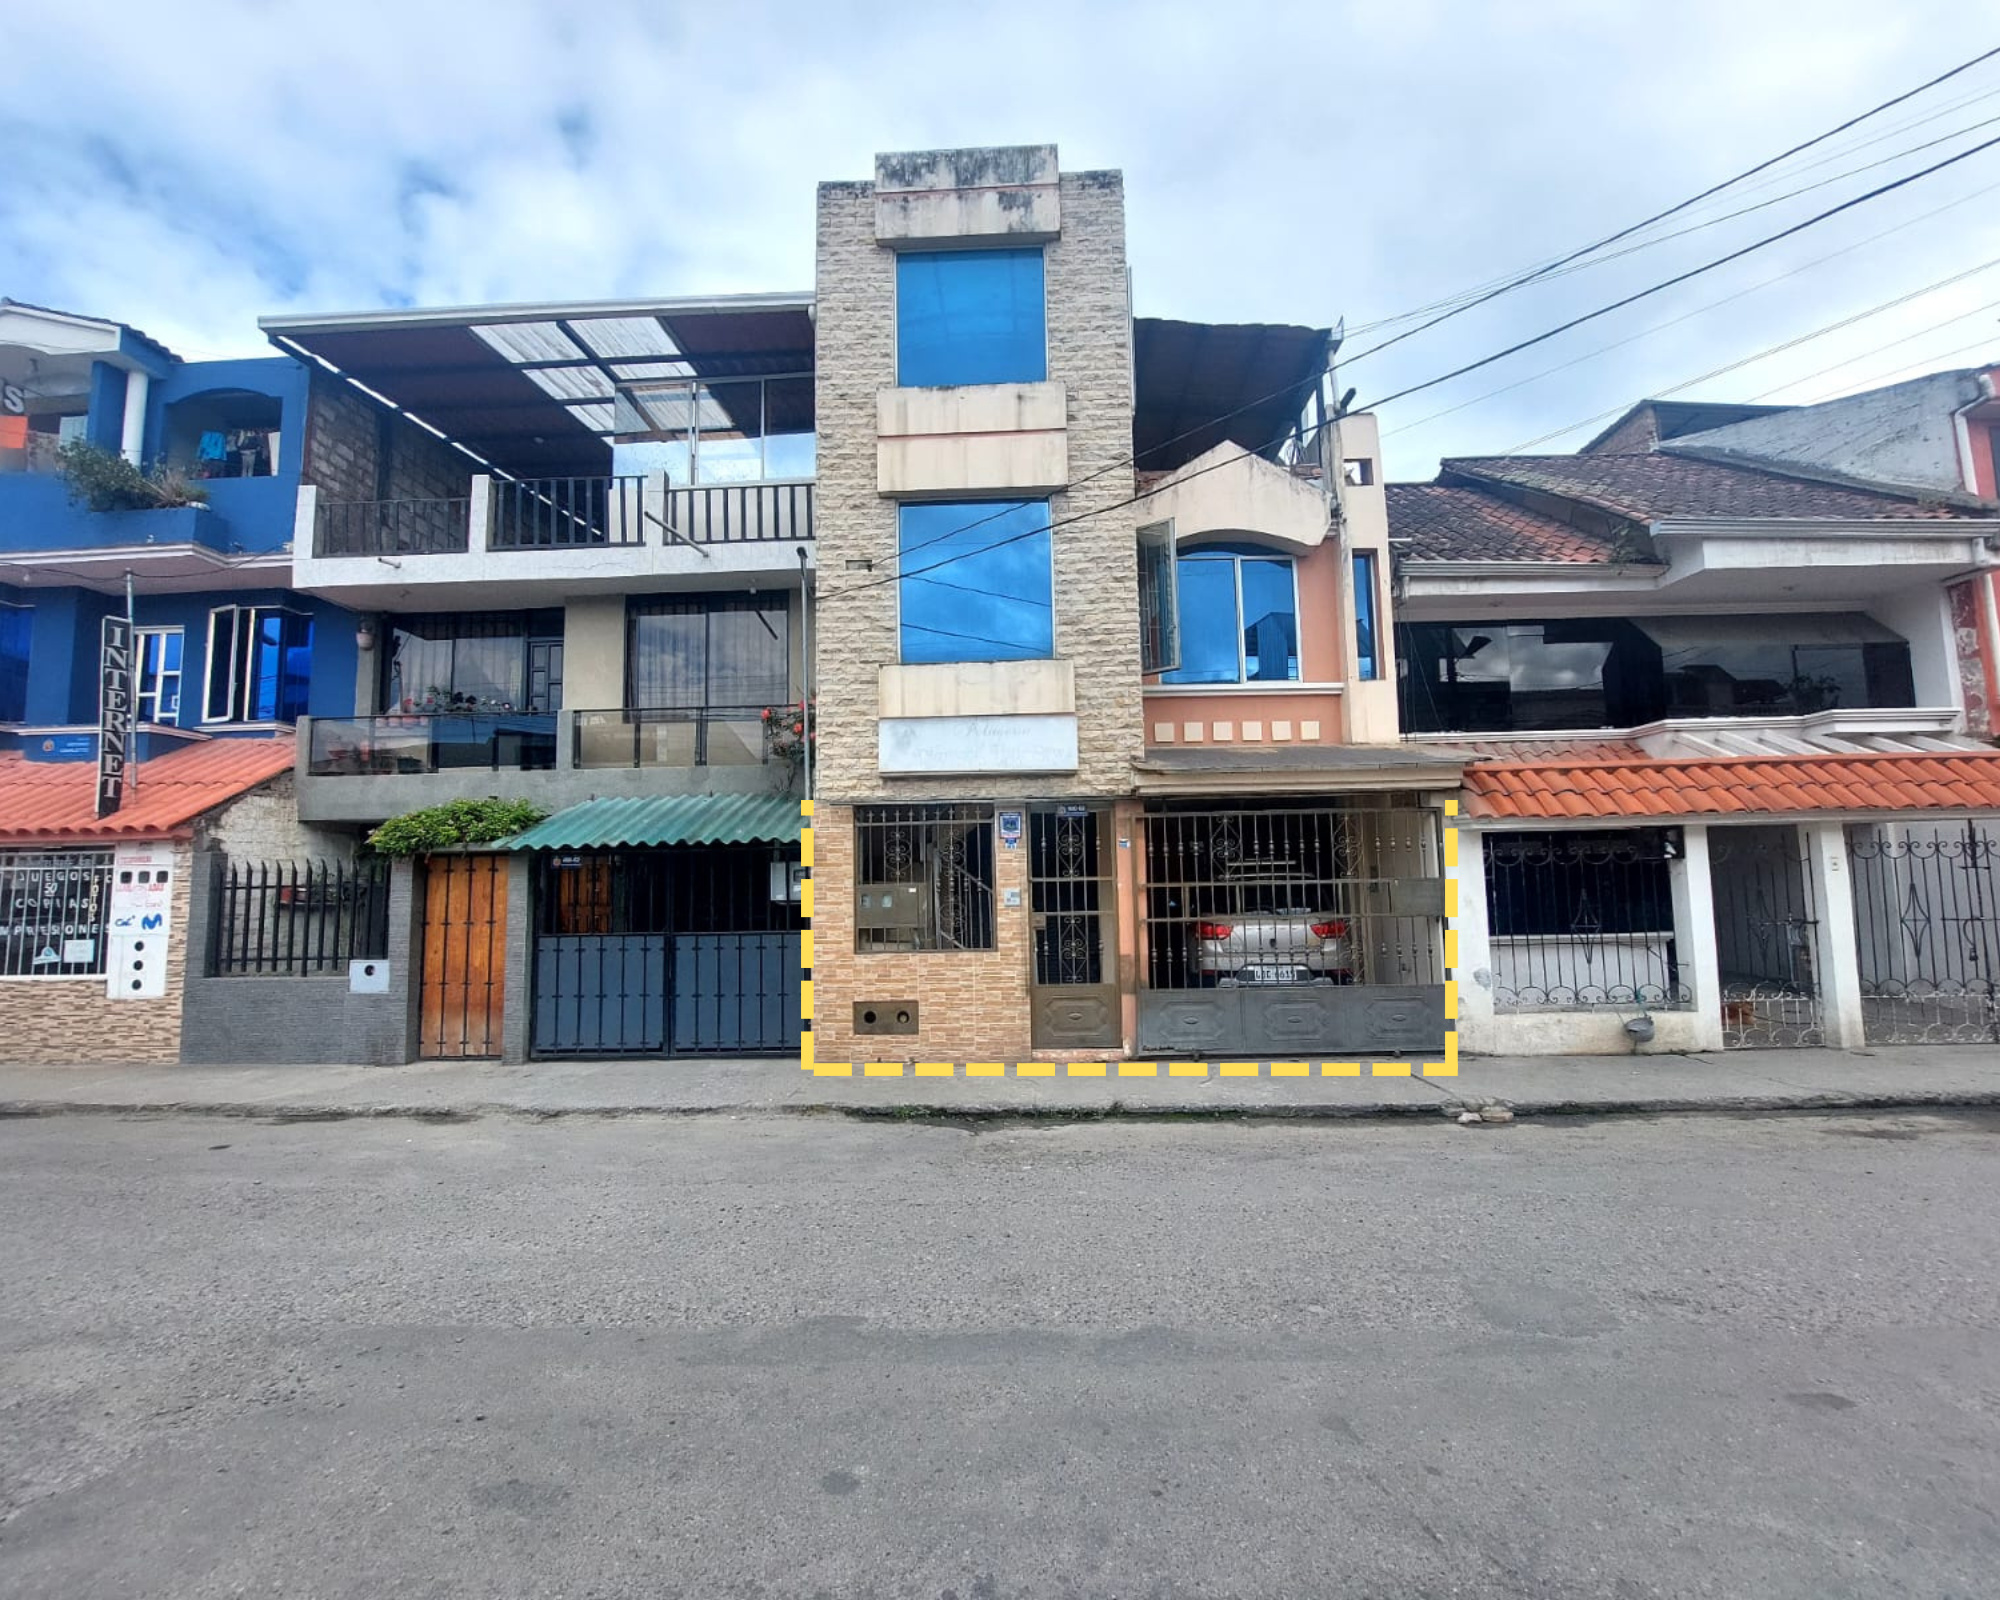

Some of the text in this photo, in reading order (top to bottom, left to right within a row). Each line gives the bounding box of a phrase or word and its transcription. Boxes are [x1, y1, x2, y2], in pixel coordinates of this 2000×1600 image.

[103, 627, 127, 798] INTERNET
[19, 871, 91, 882] JUEGOS
[16, 898, 89, 908] COPIAS
